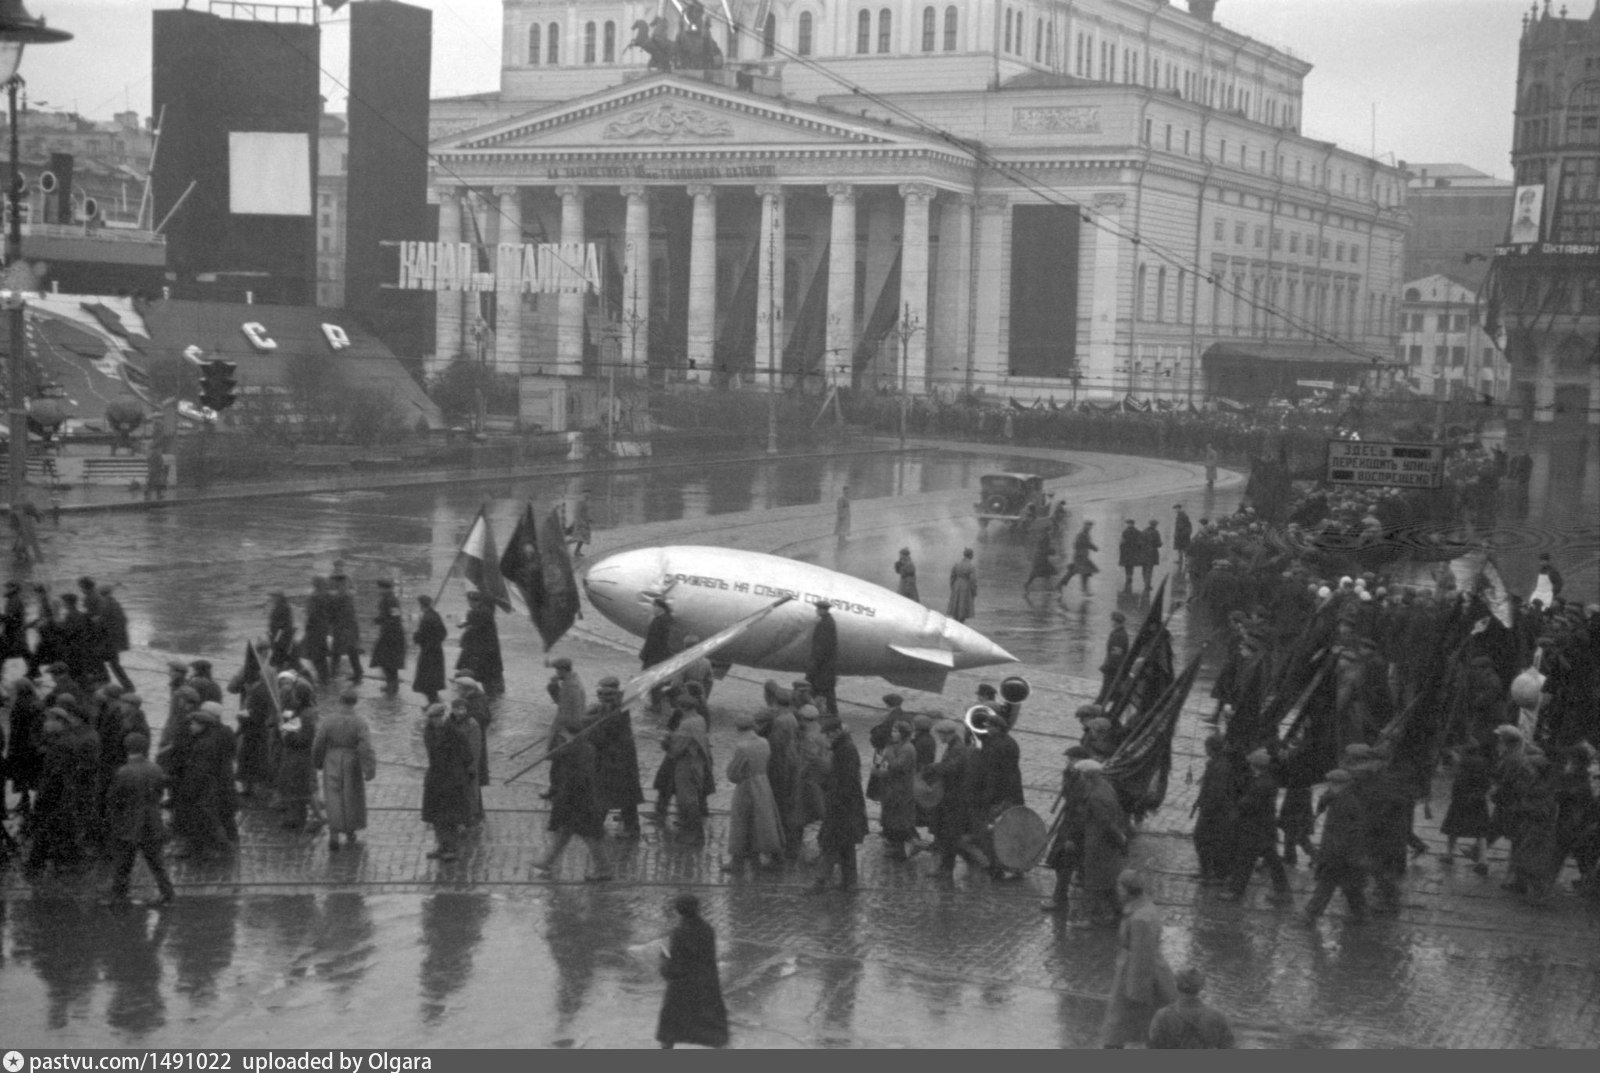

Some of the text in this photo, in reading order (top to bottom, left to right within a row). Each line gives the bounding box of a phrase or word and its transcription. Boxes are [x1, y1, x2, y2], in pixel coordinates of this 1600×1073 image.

[399, 241, 471, 291] КАНАЛ
[1344, 445, 1387, 457] ЗДЕСЬ
[1331, 456, 1439, 472] ПЕРЕХОДИТЬ УЛИЦУ
[734, 581, 750, 594] НА
[754, 584, 800, 601] СЛУЖБУ
